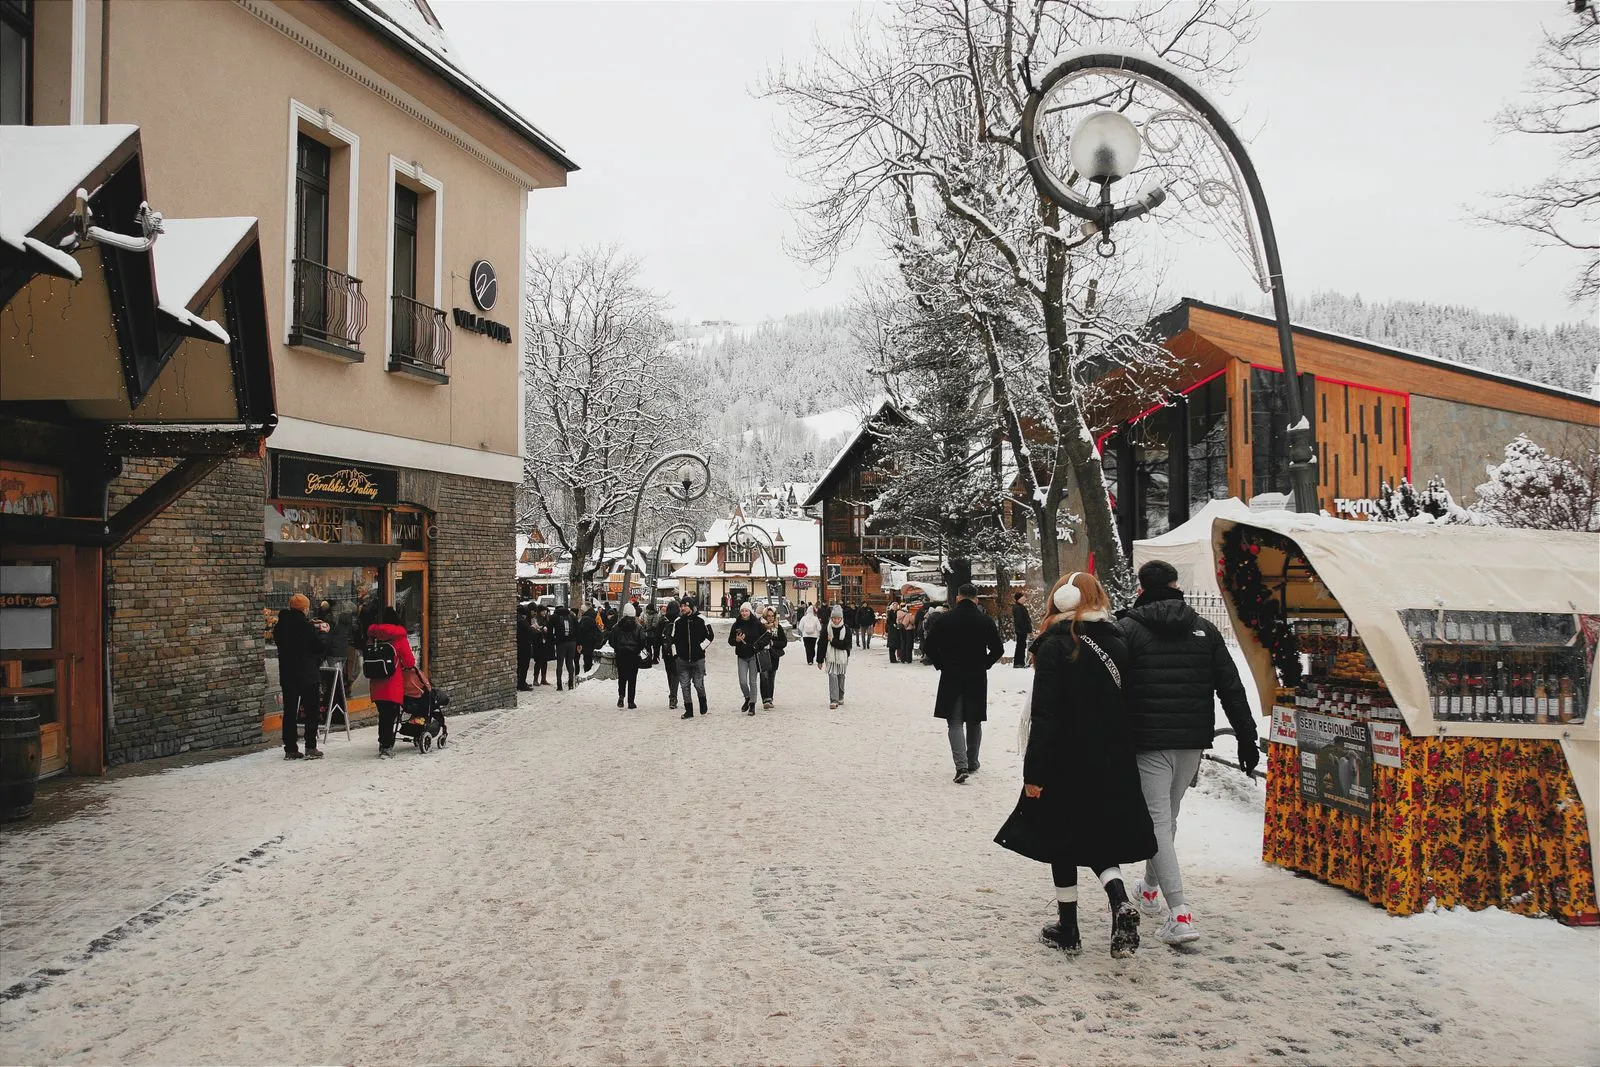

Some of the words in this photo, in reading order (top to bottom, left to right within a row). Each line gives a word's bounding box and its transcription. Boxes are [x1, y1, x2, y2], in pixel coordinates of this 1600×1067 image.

[305, 473, 345, 494] Góralskie
[346, 479, 378, 499] Praliny
[299, 506, 349, 524] SWEET
[1299, 717, 1318, 731] SERY
[1318, 720, 1366, 741] REGIONALNE
